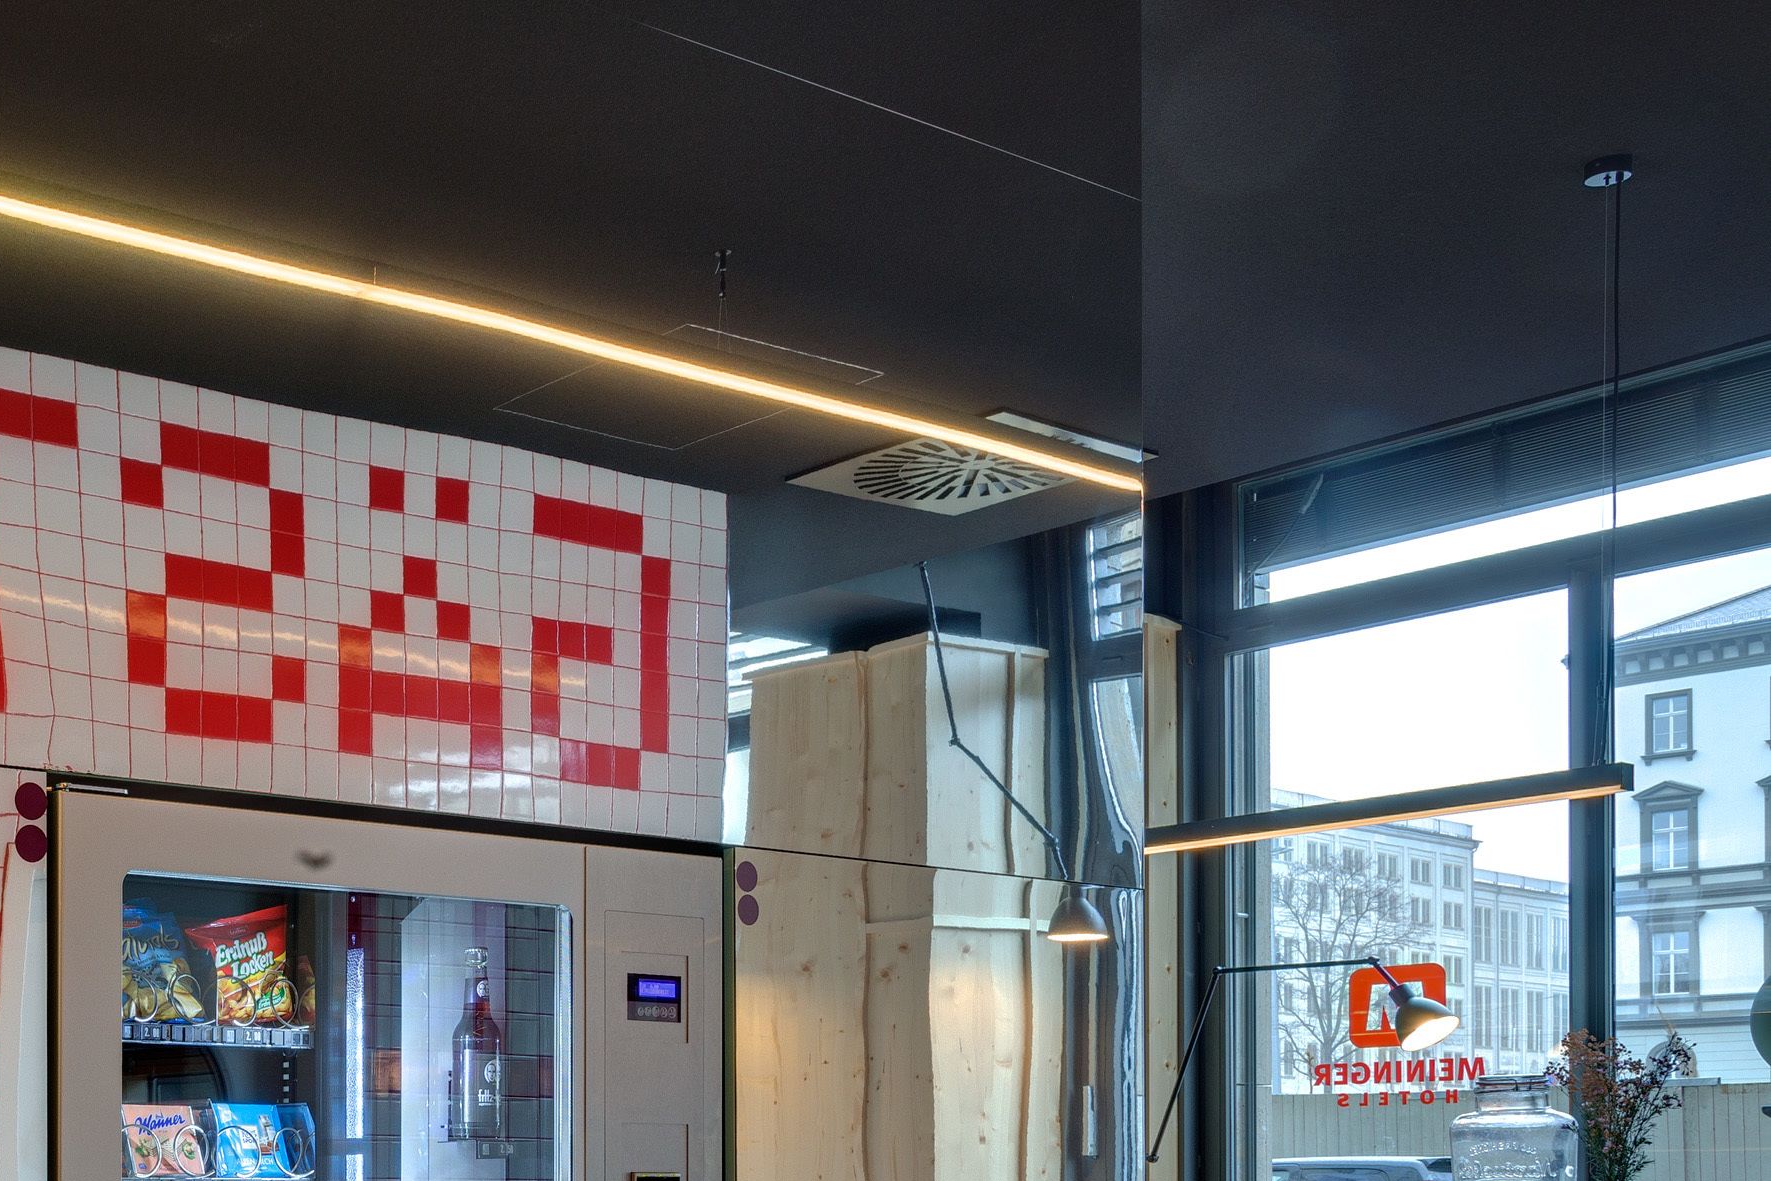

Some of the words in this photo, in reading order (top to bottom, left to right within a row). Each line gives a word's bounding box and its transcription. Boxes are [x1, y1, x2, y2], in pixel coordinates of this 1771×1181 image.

[215, 931, 268, 969] Erdnuß
[231, 950, 275, 983] Locken
[135, 1114, 185, 1135] Manner
